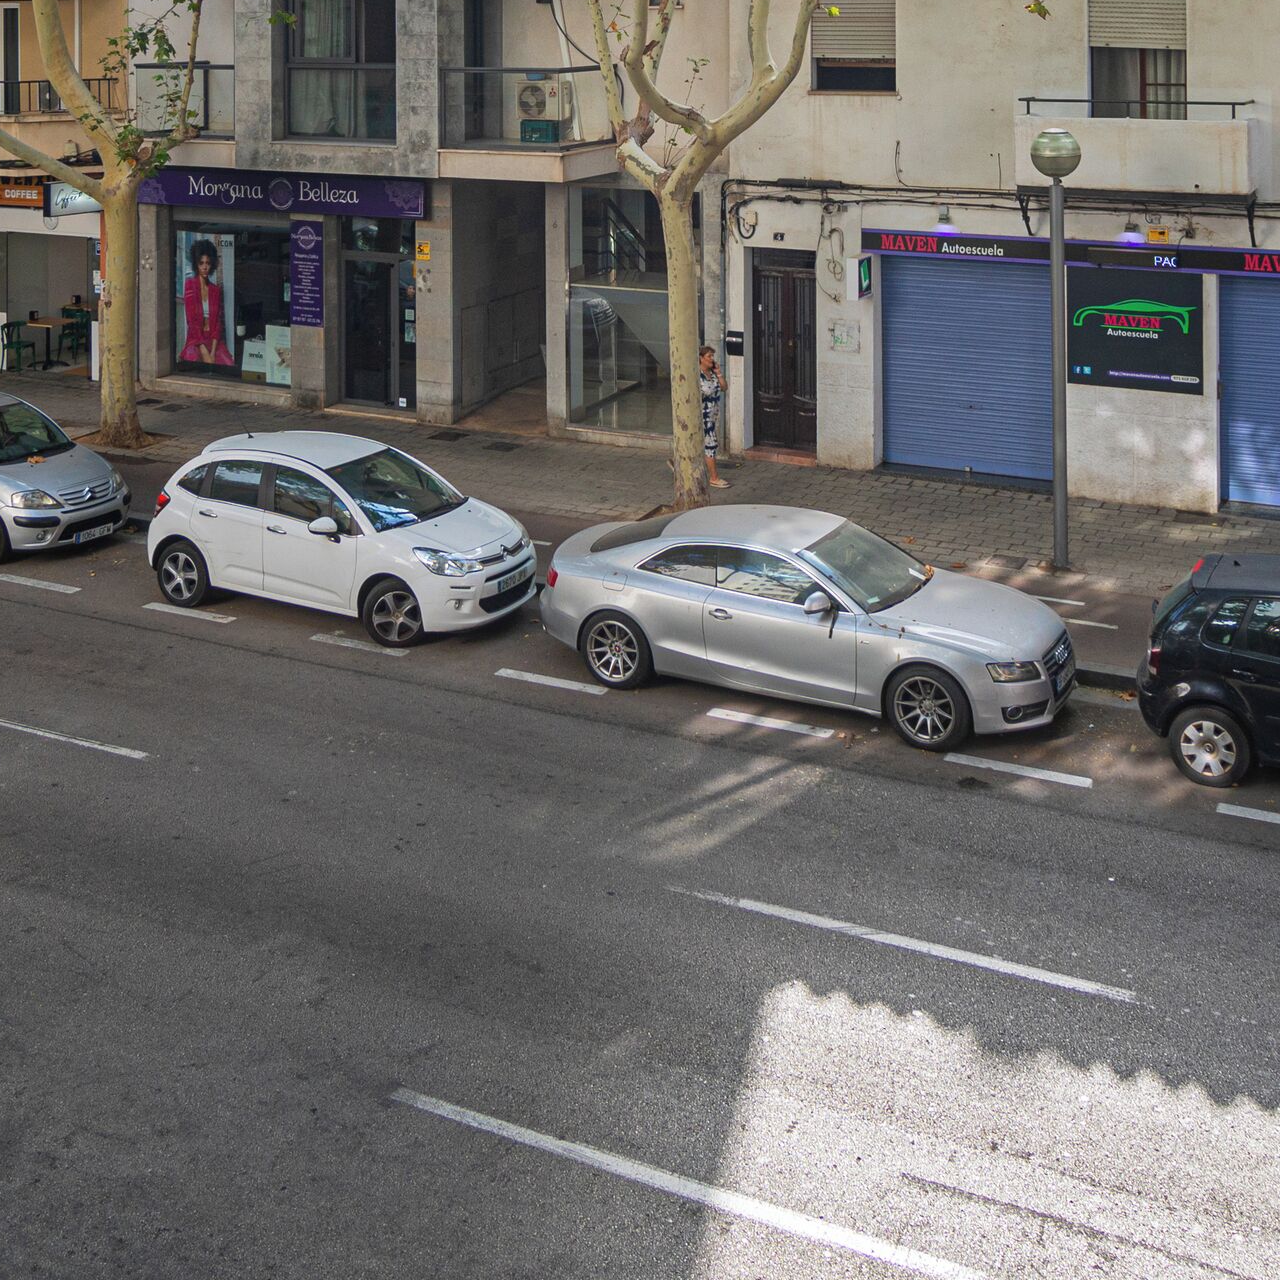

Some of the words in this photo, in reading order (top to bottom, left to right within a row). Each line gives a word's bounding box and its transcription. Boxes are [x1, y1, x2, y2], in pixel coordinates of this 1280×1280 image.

[4, 189, 39, 199] COFFEE
[188, 175, 263, 204] Morgana
[298, 180, 360, 204] Belleza
[217, 239, 233, 247] ICON
[880, 234, 938, 252] MAVEN
[941, 242, 1004, 256] Autoescuela
[1104, 313, 1162, 329] MAVEN
[1106, 328, 1159, 339] Autoescuela
